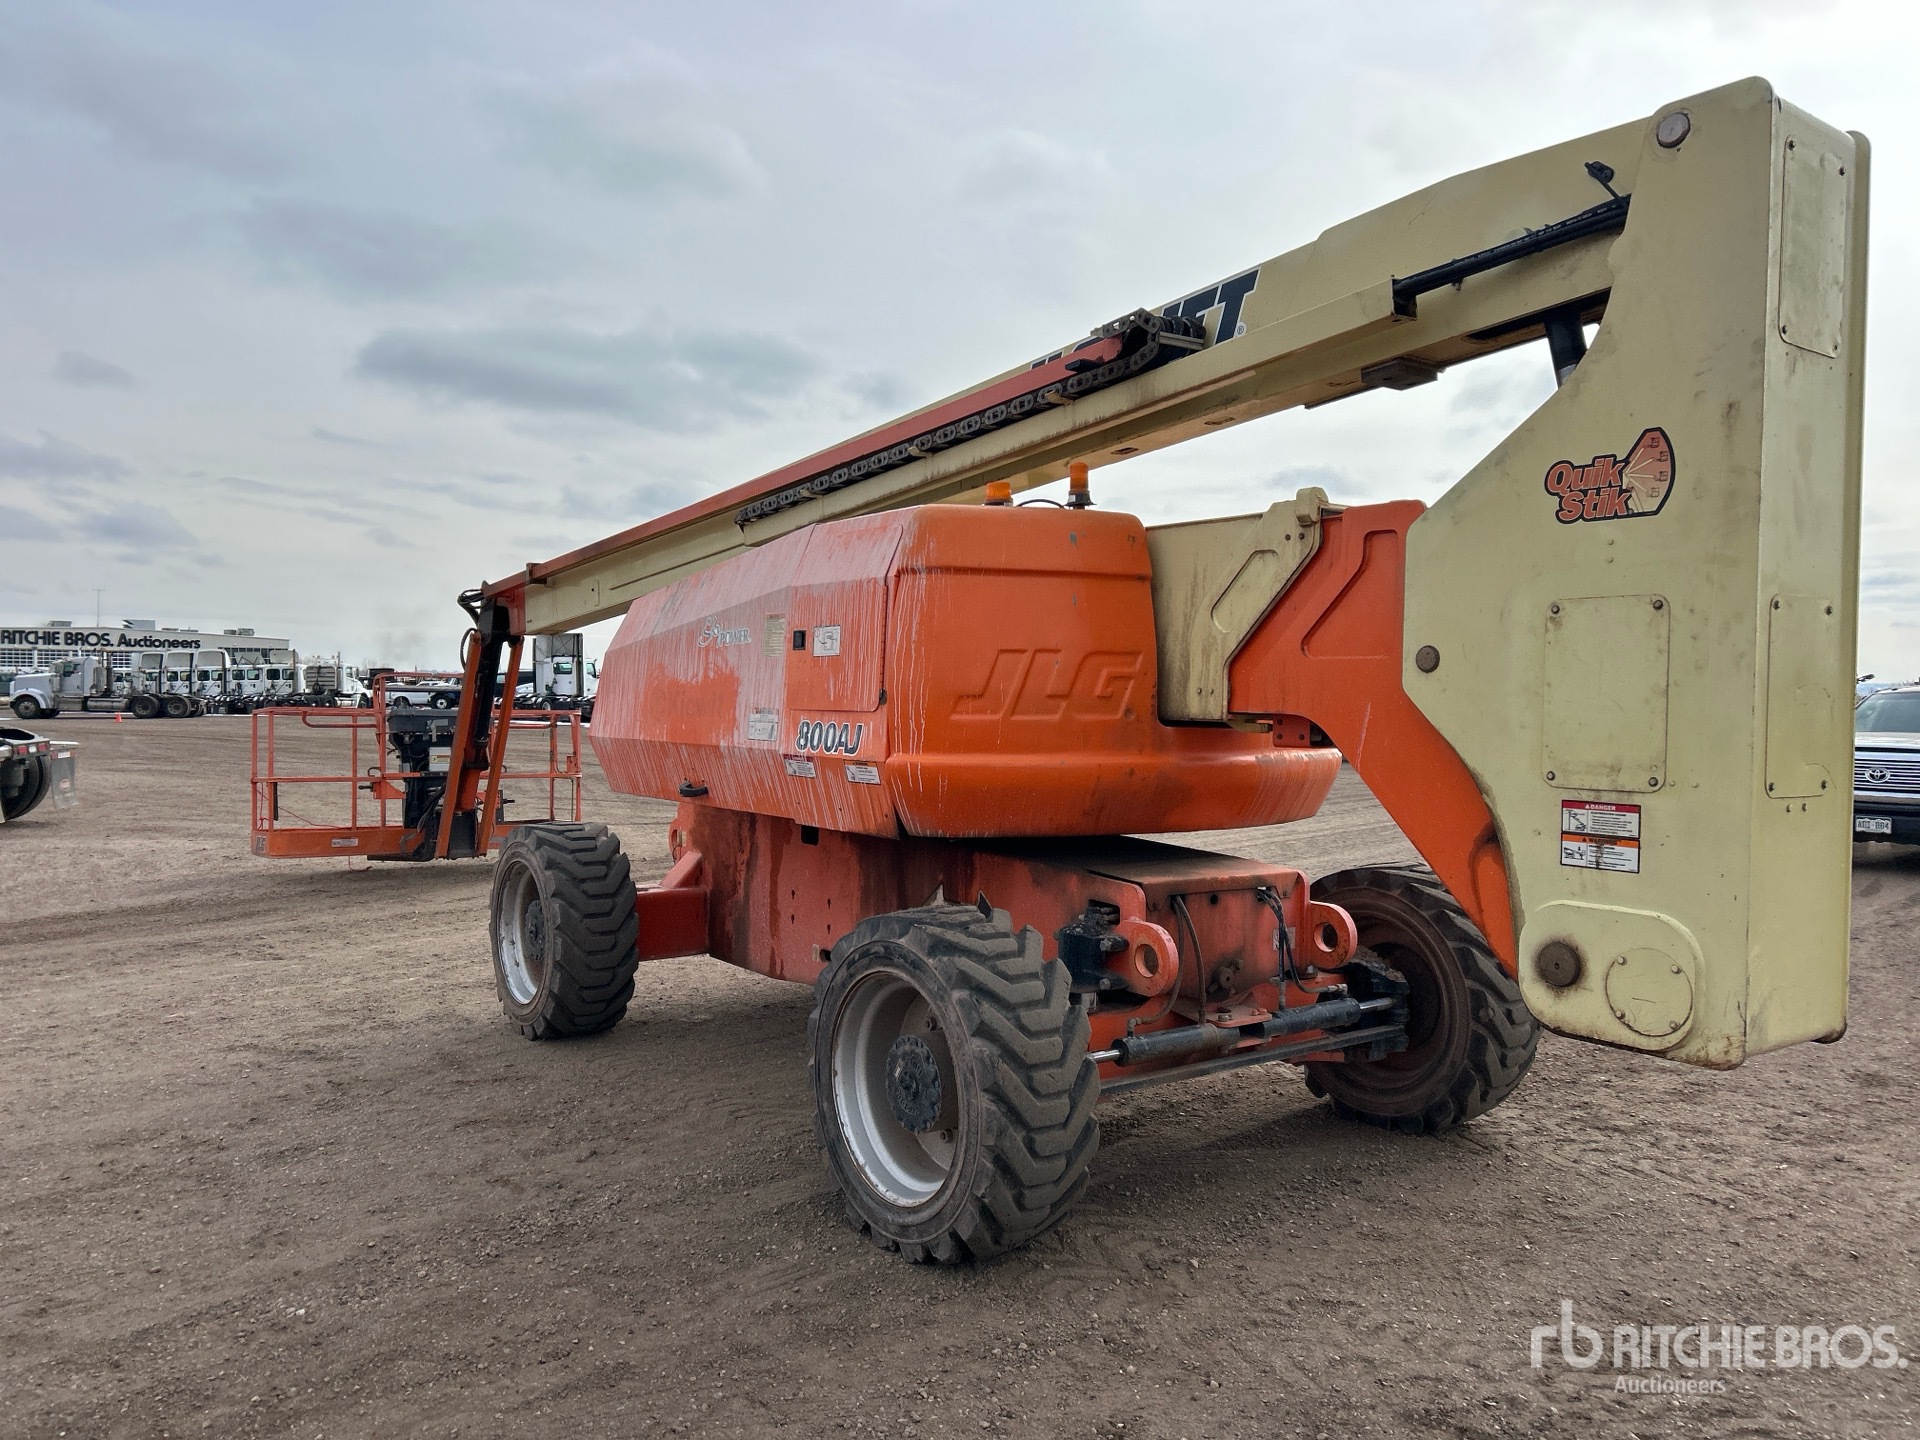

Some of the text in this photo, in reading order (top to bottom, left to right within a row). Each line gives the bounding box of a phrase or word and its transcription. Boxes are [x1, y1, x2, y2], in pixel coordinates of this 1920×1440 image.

[1547, 457, 1625, 497] Quik
[1557, 486, 1632, 521] Stik
[0, 629, 201, 649] RITCHIE BROS. Auctioneers
[950, 648, 1144, 720] JLG
[795, 720, 864, 756] 800AJ
